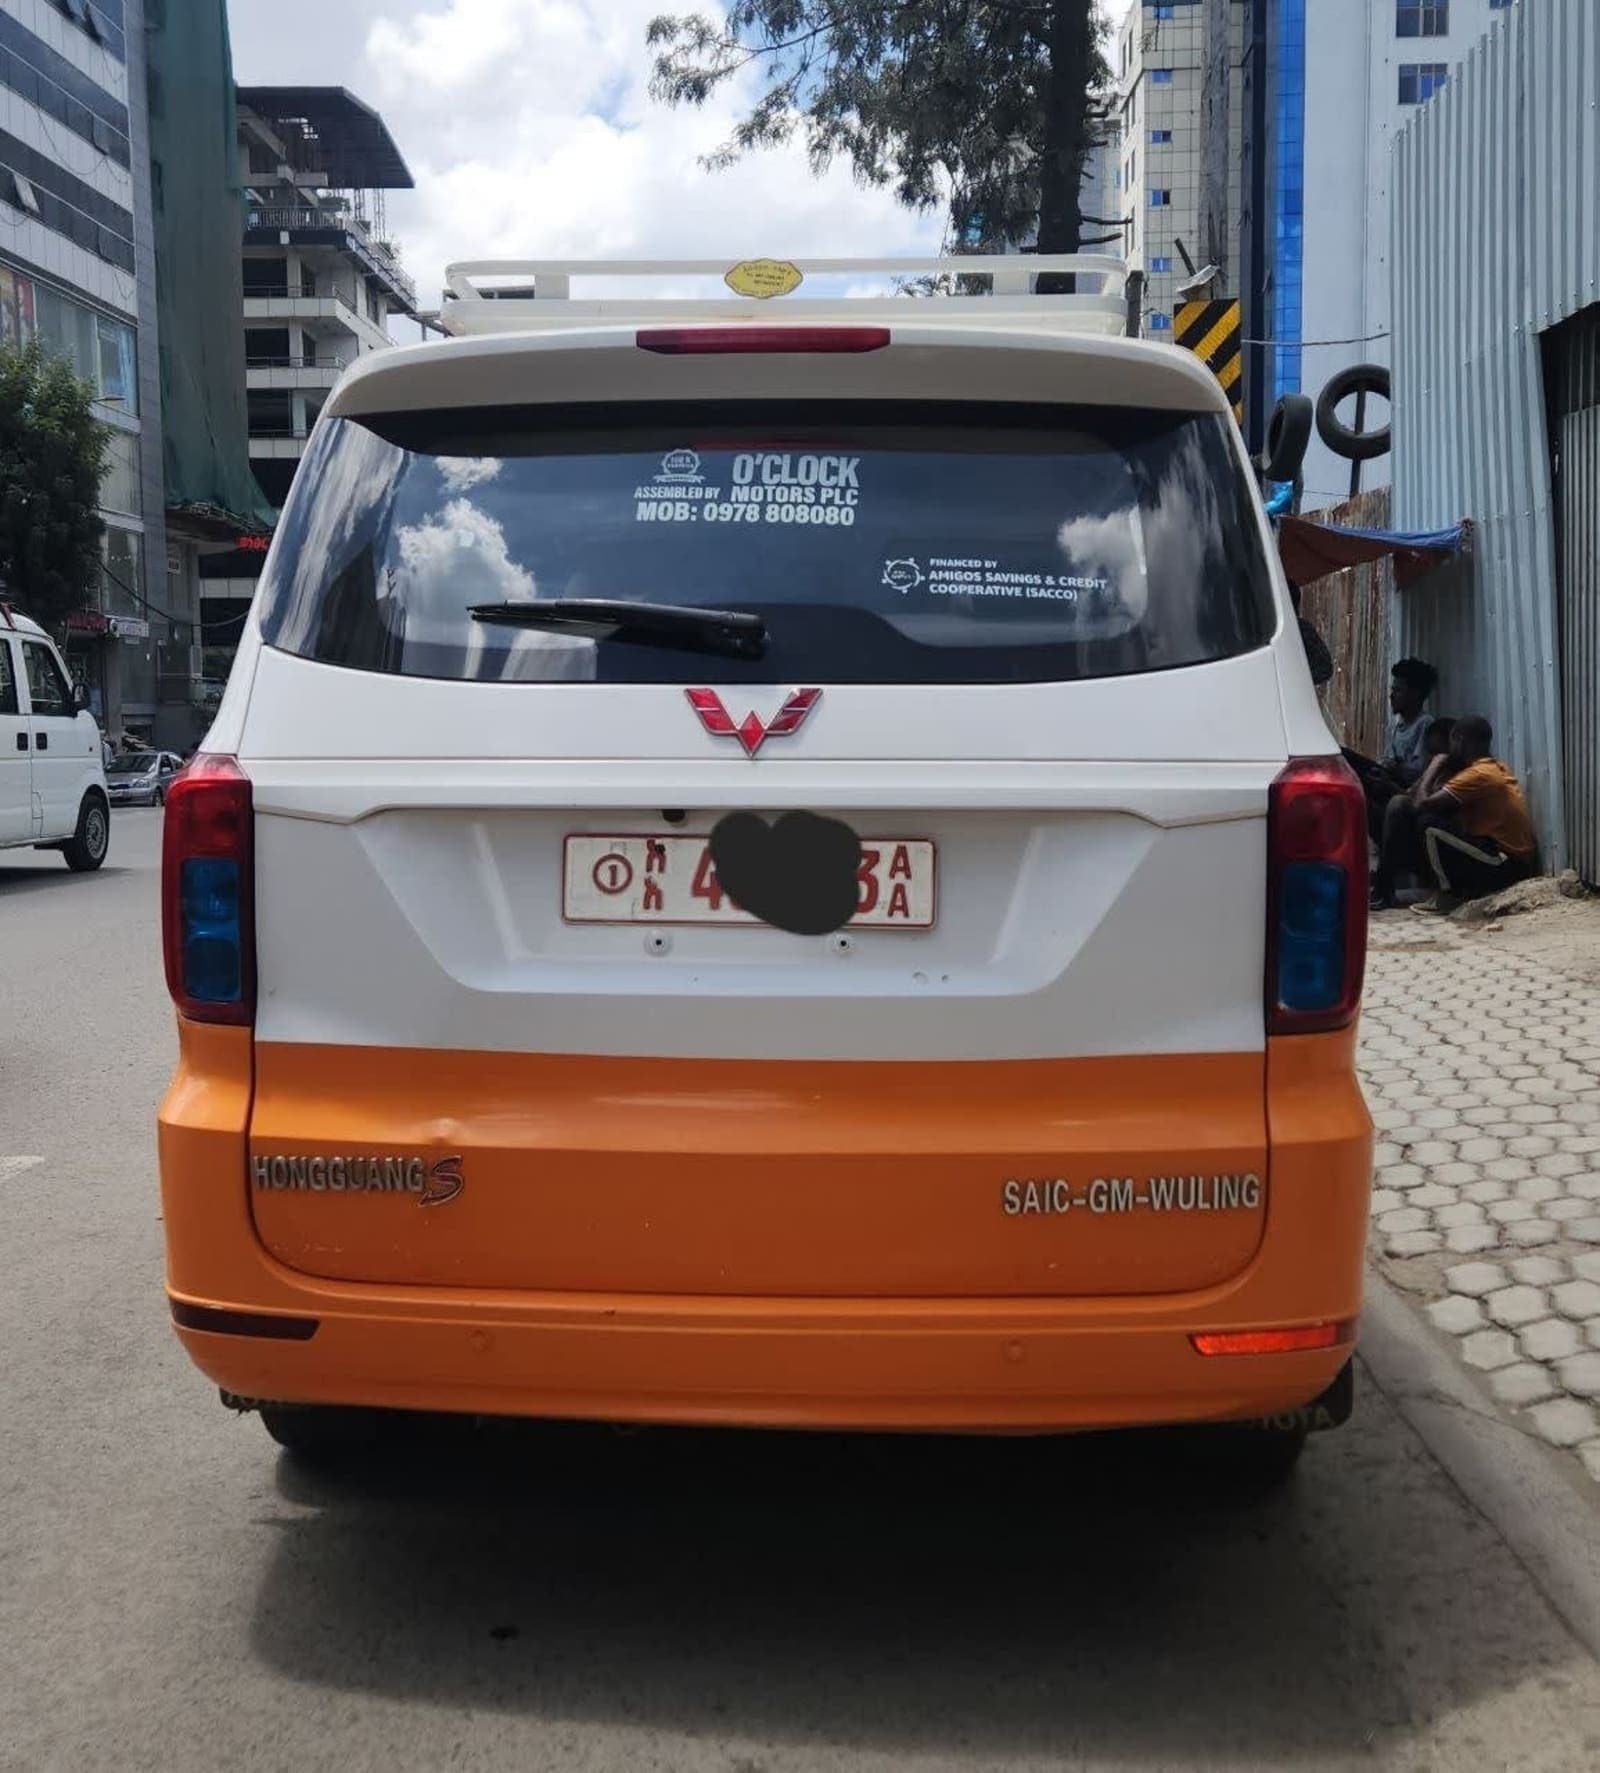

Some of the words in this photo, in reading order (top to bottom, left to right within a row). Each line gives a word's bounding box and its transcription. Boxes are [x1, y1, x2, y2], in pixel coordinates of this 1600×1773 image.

[732, 453, 861, 487] O'CLOCK
[634, 486, 703, 499] ASSEMBLED
[704, 487, 720, 499] BY
[730, 486, 815, 503] MOTORS
[820, 489, 859, 505] PLC
[636, 501, 698, 521] MOB:
[703, 502, 760, 522] 0978
[765, 505, 855, 525] 808080
[929, 558, 982, 568] FINANCED
[984, 559, 998, 568] BY
[929, 571, 981, 582] AMIGOS
[985, 572, 1042, 585] SAVINGS
[1044, 577, 1056, 585] &
[1059, 577, 1108, 589] CREDIT
[929, 583, 1022, 597] COOPERATIVE
[1026, 587, 1078, 601] (SACCO)
[253, 1156, 423, 1191] HONGGUANG
[416, 1155, 464, 1207] S
[1004, 1174, 1260, 1214] SAIC-GM-WULING
